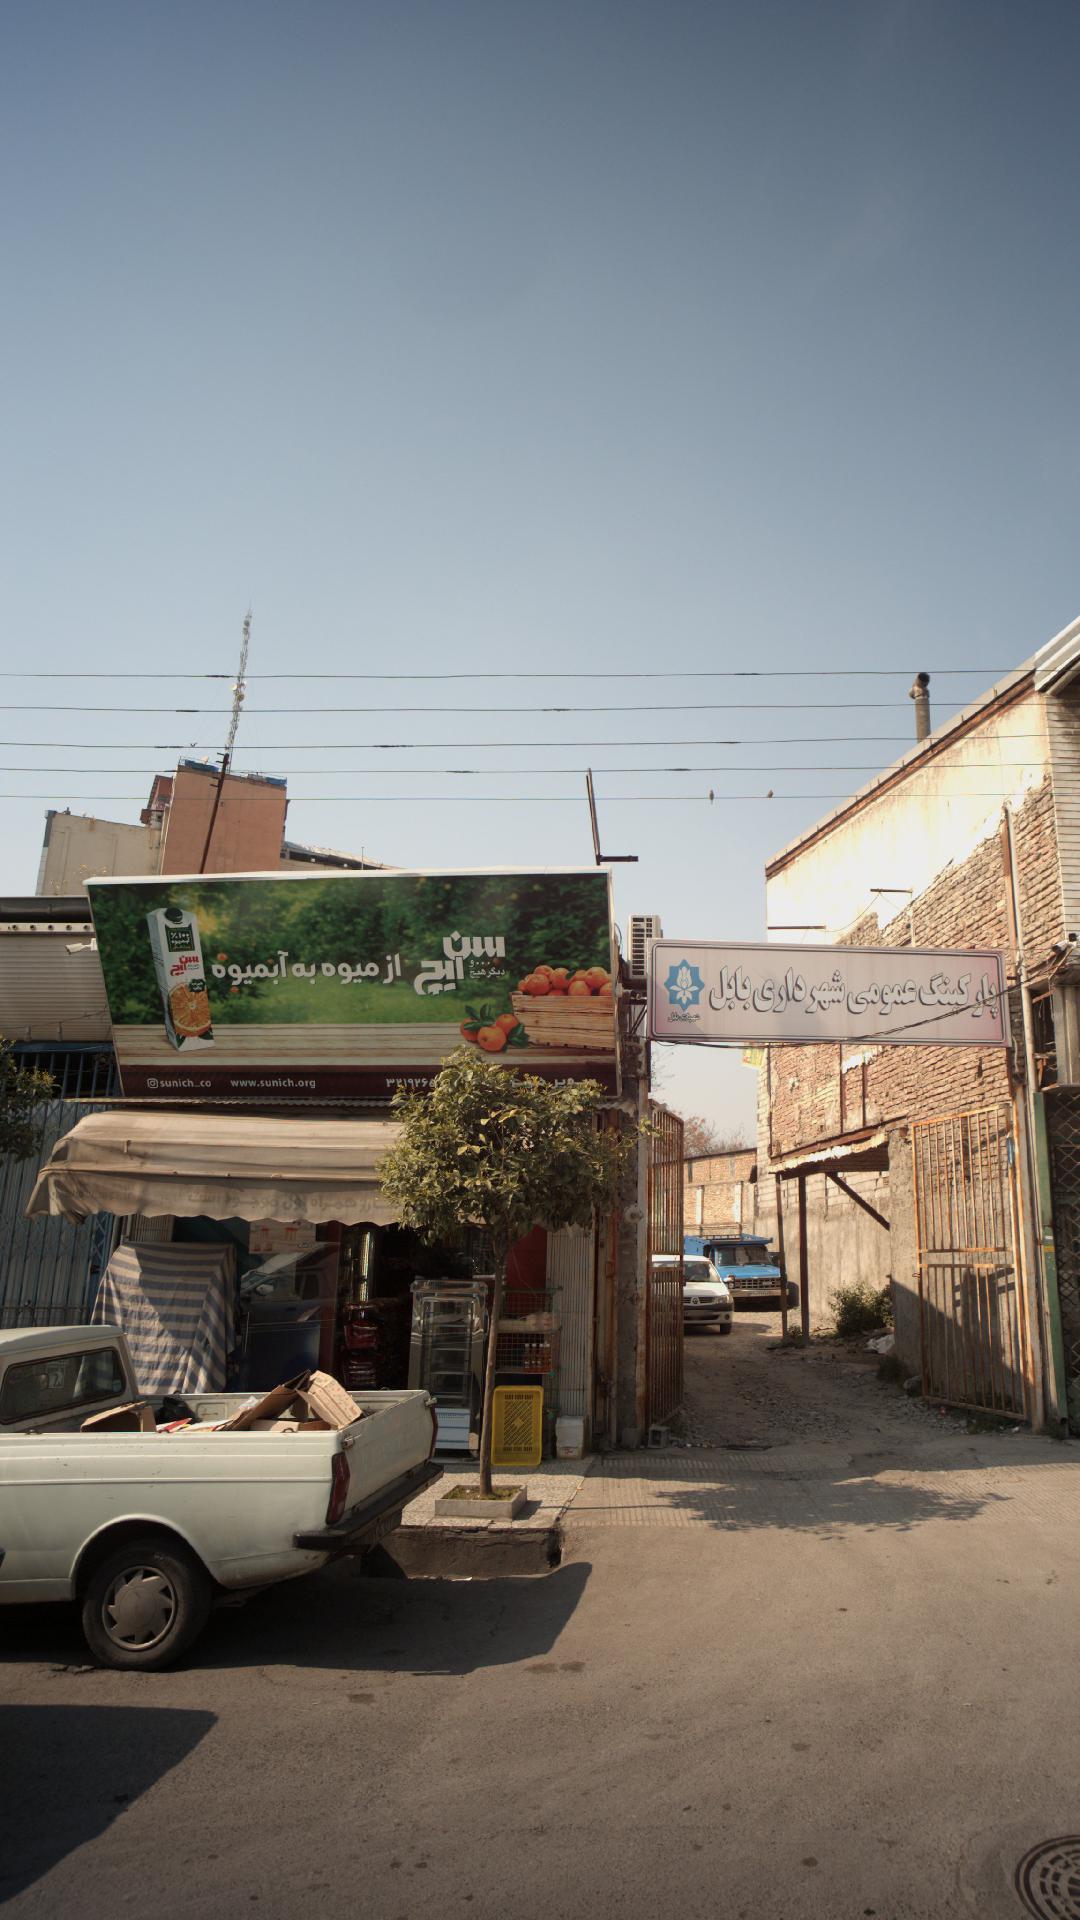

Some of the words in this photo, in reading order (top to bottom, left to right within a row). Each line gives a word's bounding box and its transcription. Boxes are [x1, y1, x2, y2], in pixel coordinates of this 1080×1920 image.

[443, 930, 506, 961] سن
[211, 951, 289, 986] آبمیوه
[291, 962, 316, 985] به
[321, 962, 380, 985] میوه
[383, 953, 402, 984] از
[413, 956, 465, 996] ایچ
[709, 965, 752, 1011] بابل
[847, 979, 918, 1015] عمومی
[159, 1078, 212, 1088] sunich_co
[230, 1078, 316, 1089] www.sunich.org
